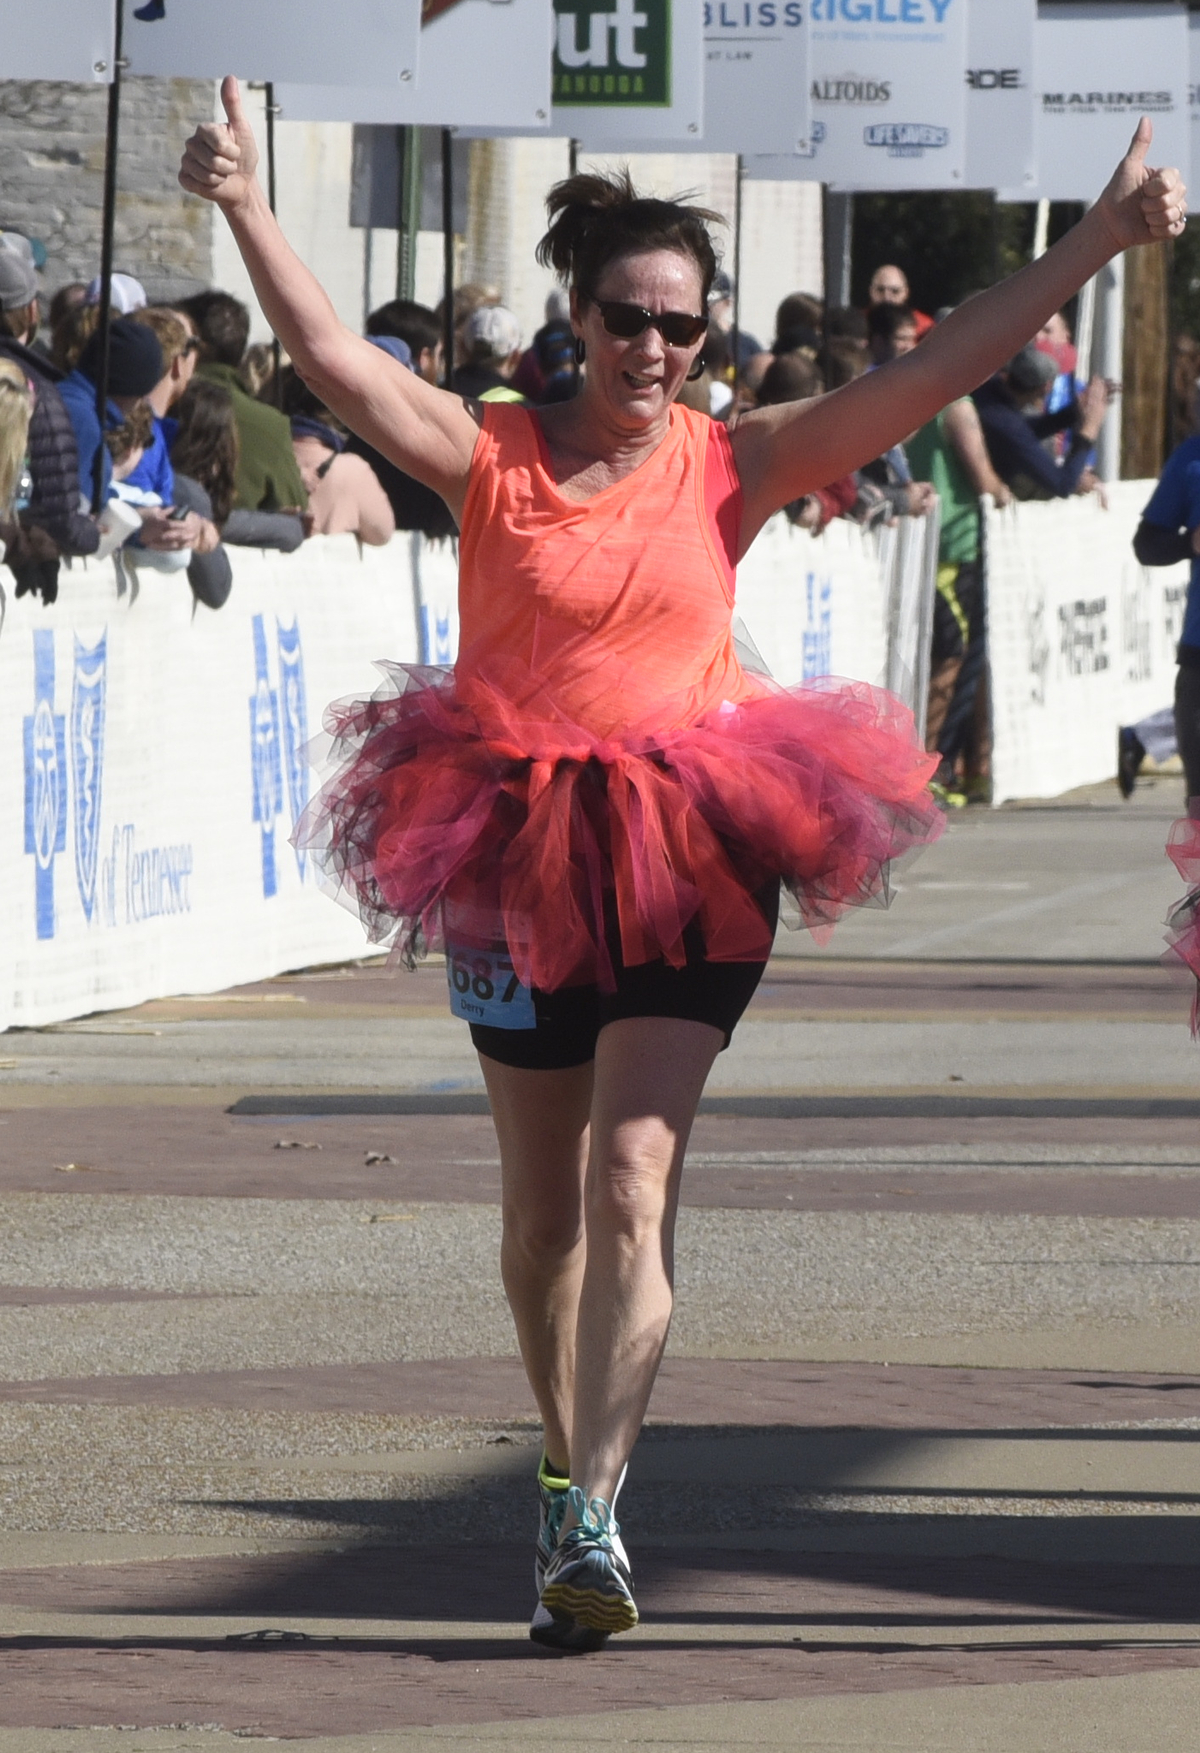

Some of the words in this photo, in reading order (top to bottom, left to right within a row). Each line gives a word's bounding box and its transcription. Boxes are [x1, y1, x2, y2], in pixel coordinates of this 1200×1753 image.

[553, 0, 647, 68] ut
[810, 80, 891, 101] ALTOIDS
[1042, 92, 1172, 105] MARINES
[448, 953, 520, 1003] 687
